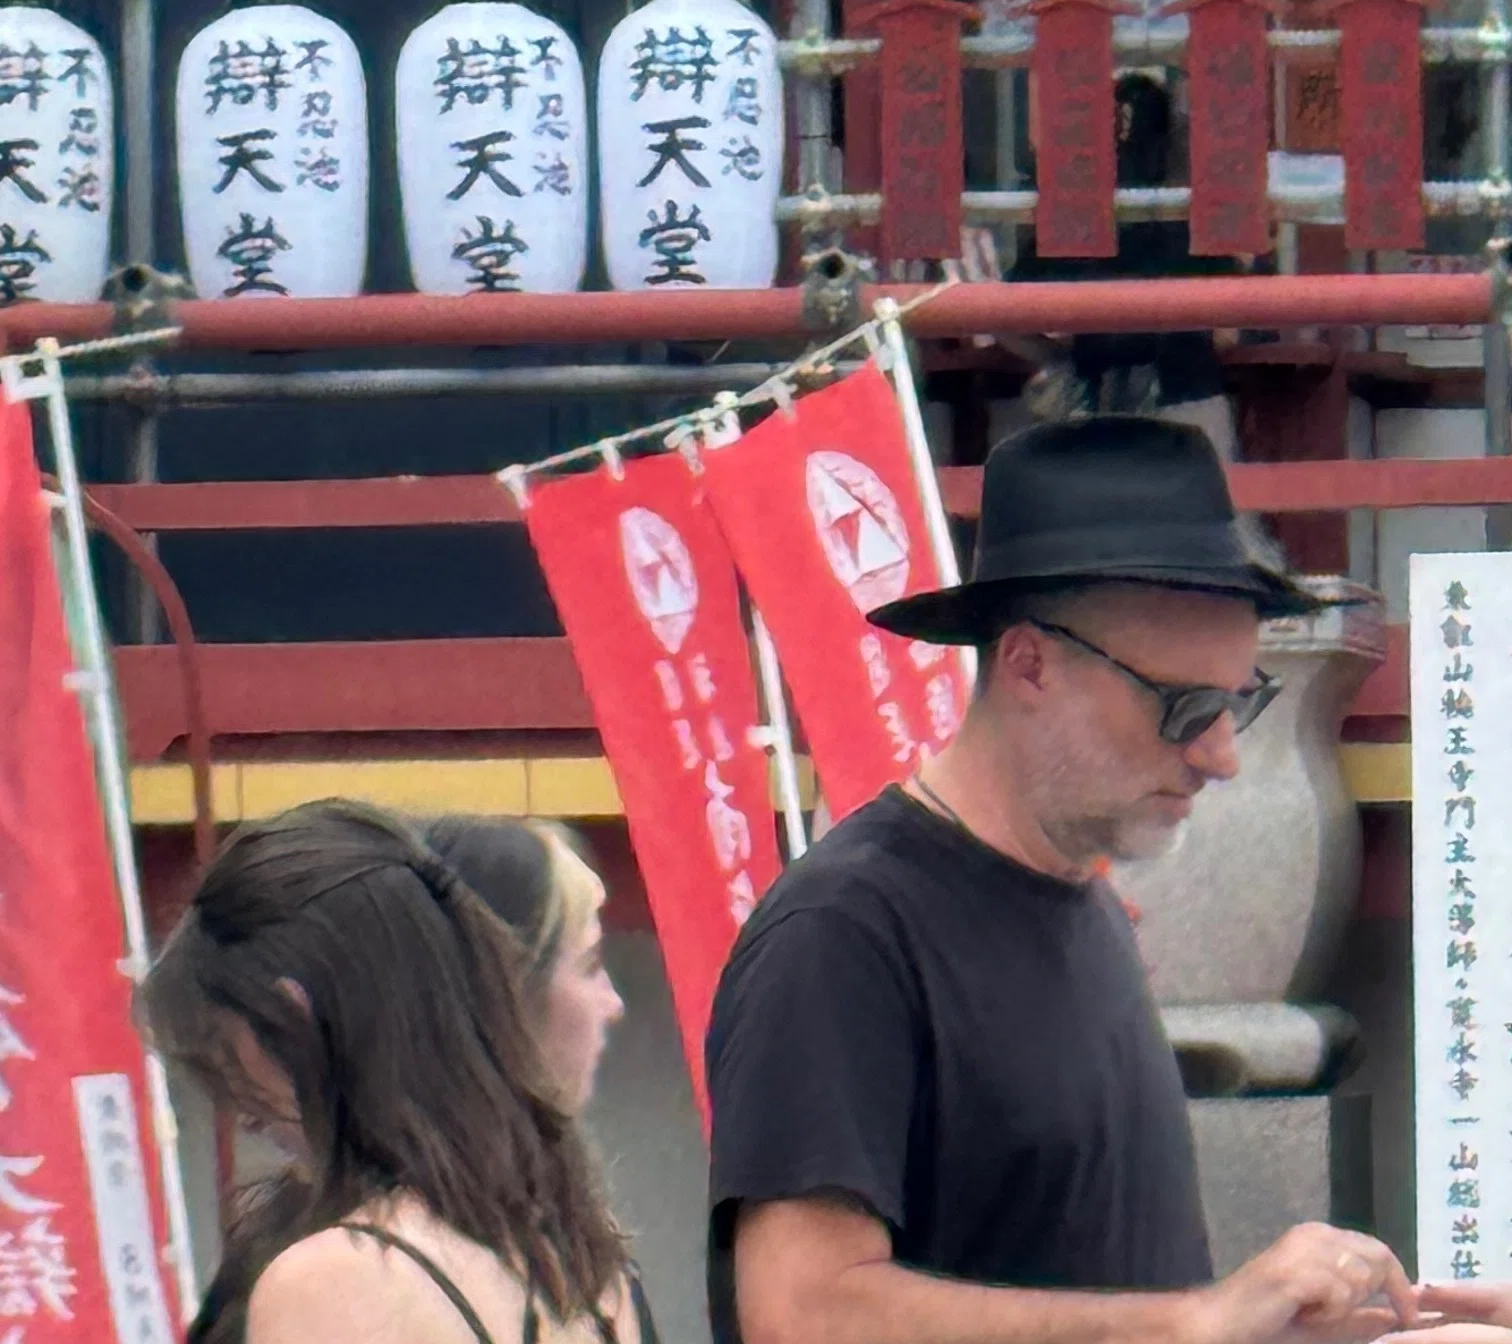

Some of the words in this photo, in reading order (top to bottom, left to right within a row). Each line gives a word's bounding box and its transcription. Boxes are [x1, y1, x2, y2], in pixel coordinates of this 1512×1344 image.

[57, 46, 103, 213] 不忍池
[294, 40, 340, 192] 不忍池
[530, 32, 574, 196] 不忍池
[716, 29, 764, 181] 不忍池
